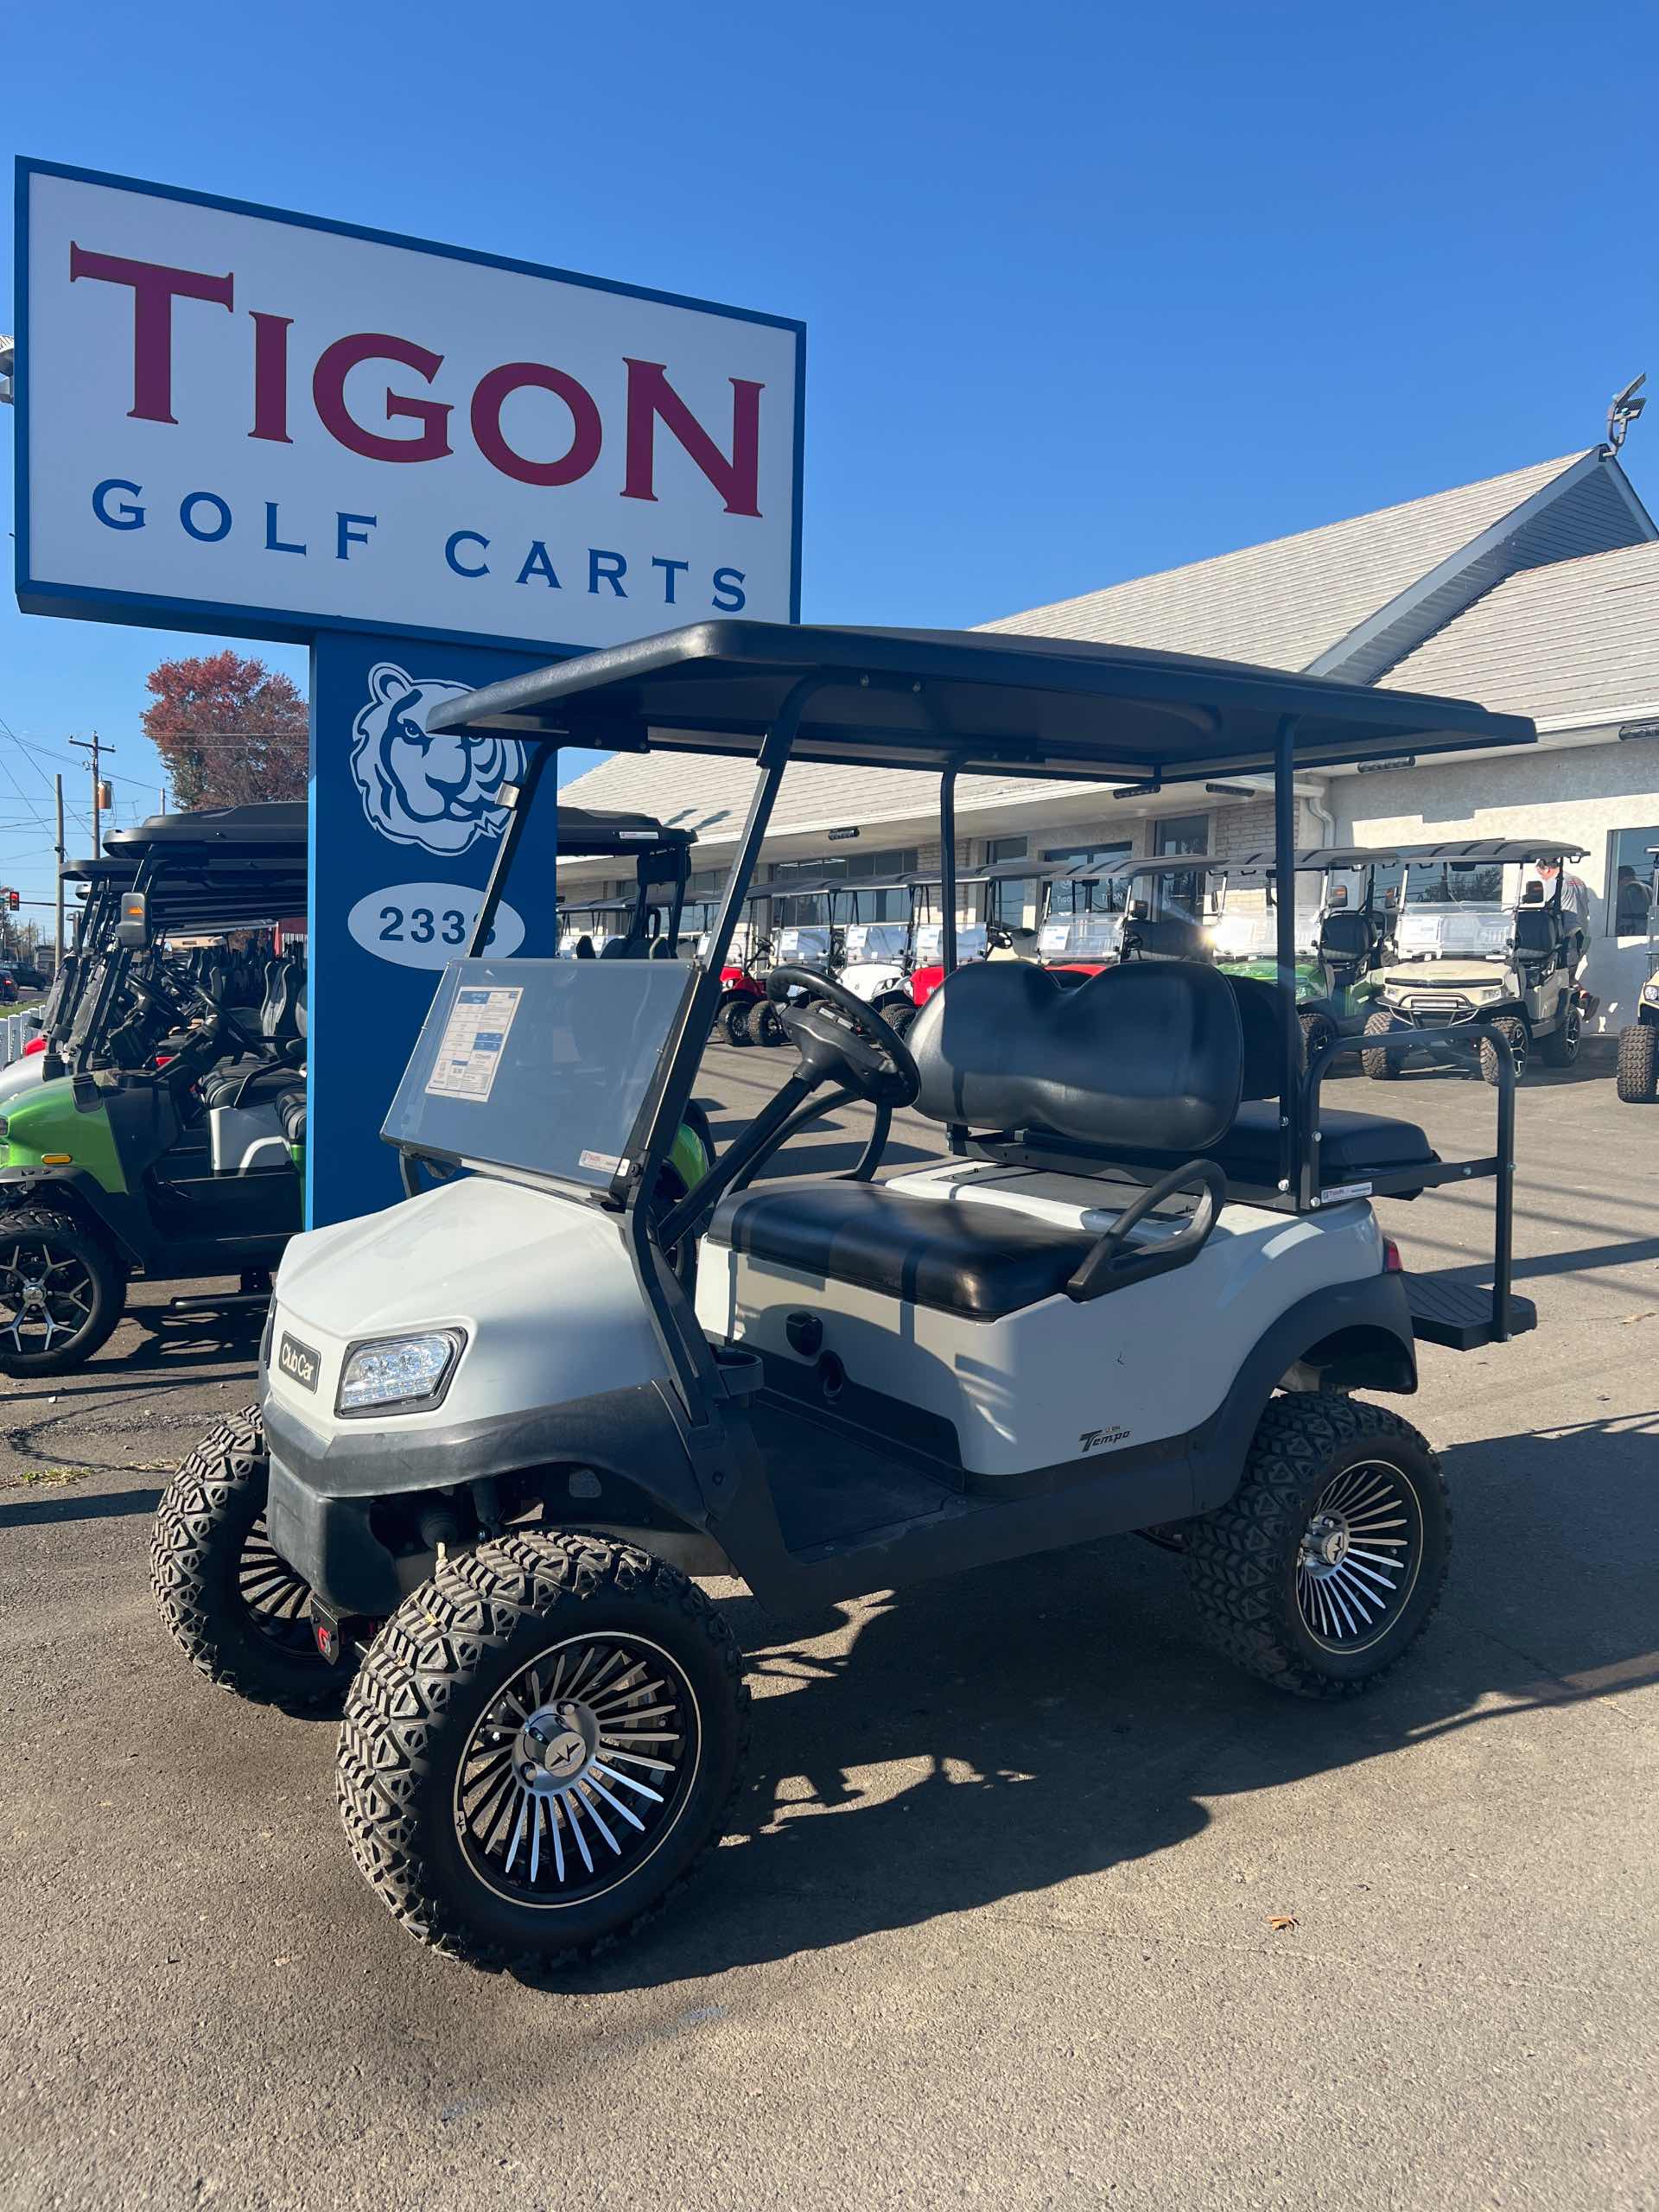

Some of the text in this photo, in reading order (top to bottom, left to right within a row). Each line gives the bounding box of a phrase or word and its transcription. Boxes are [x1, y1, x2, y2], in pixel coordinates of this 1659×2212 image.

[70, 241, 766, 518] TIGON
[92, 479, 747, 613] GOLF CARTS
[283, 1344, 314, 1381] Club Car
[1079, 1430, 1131, 1452] Tempo
